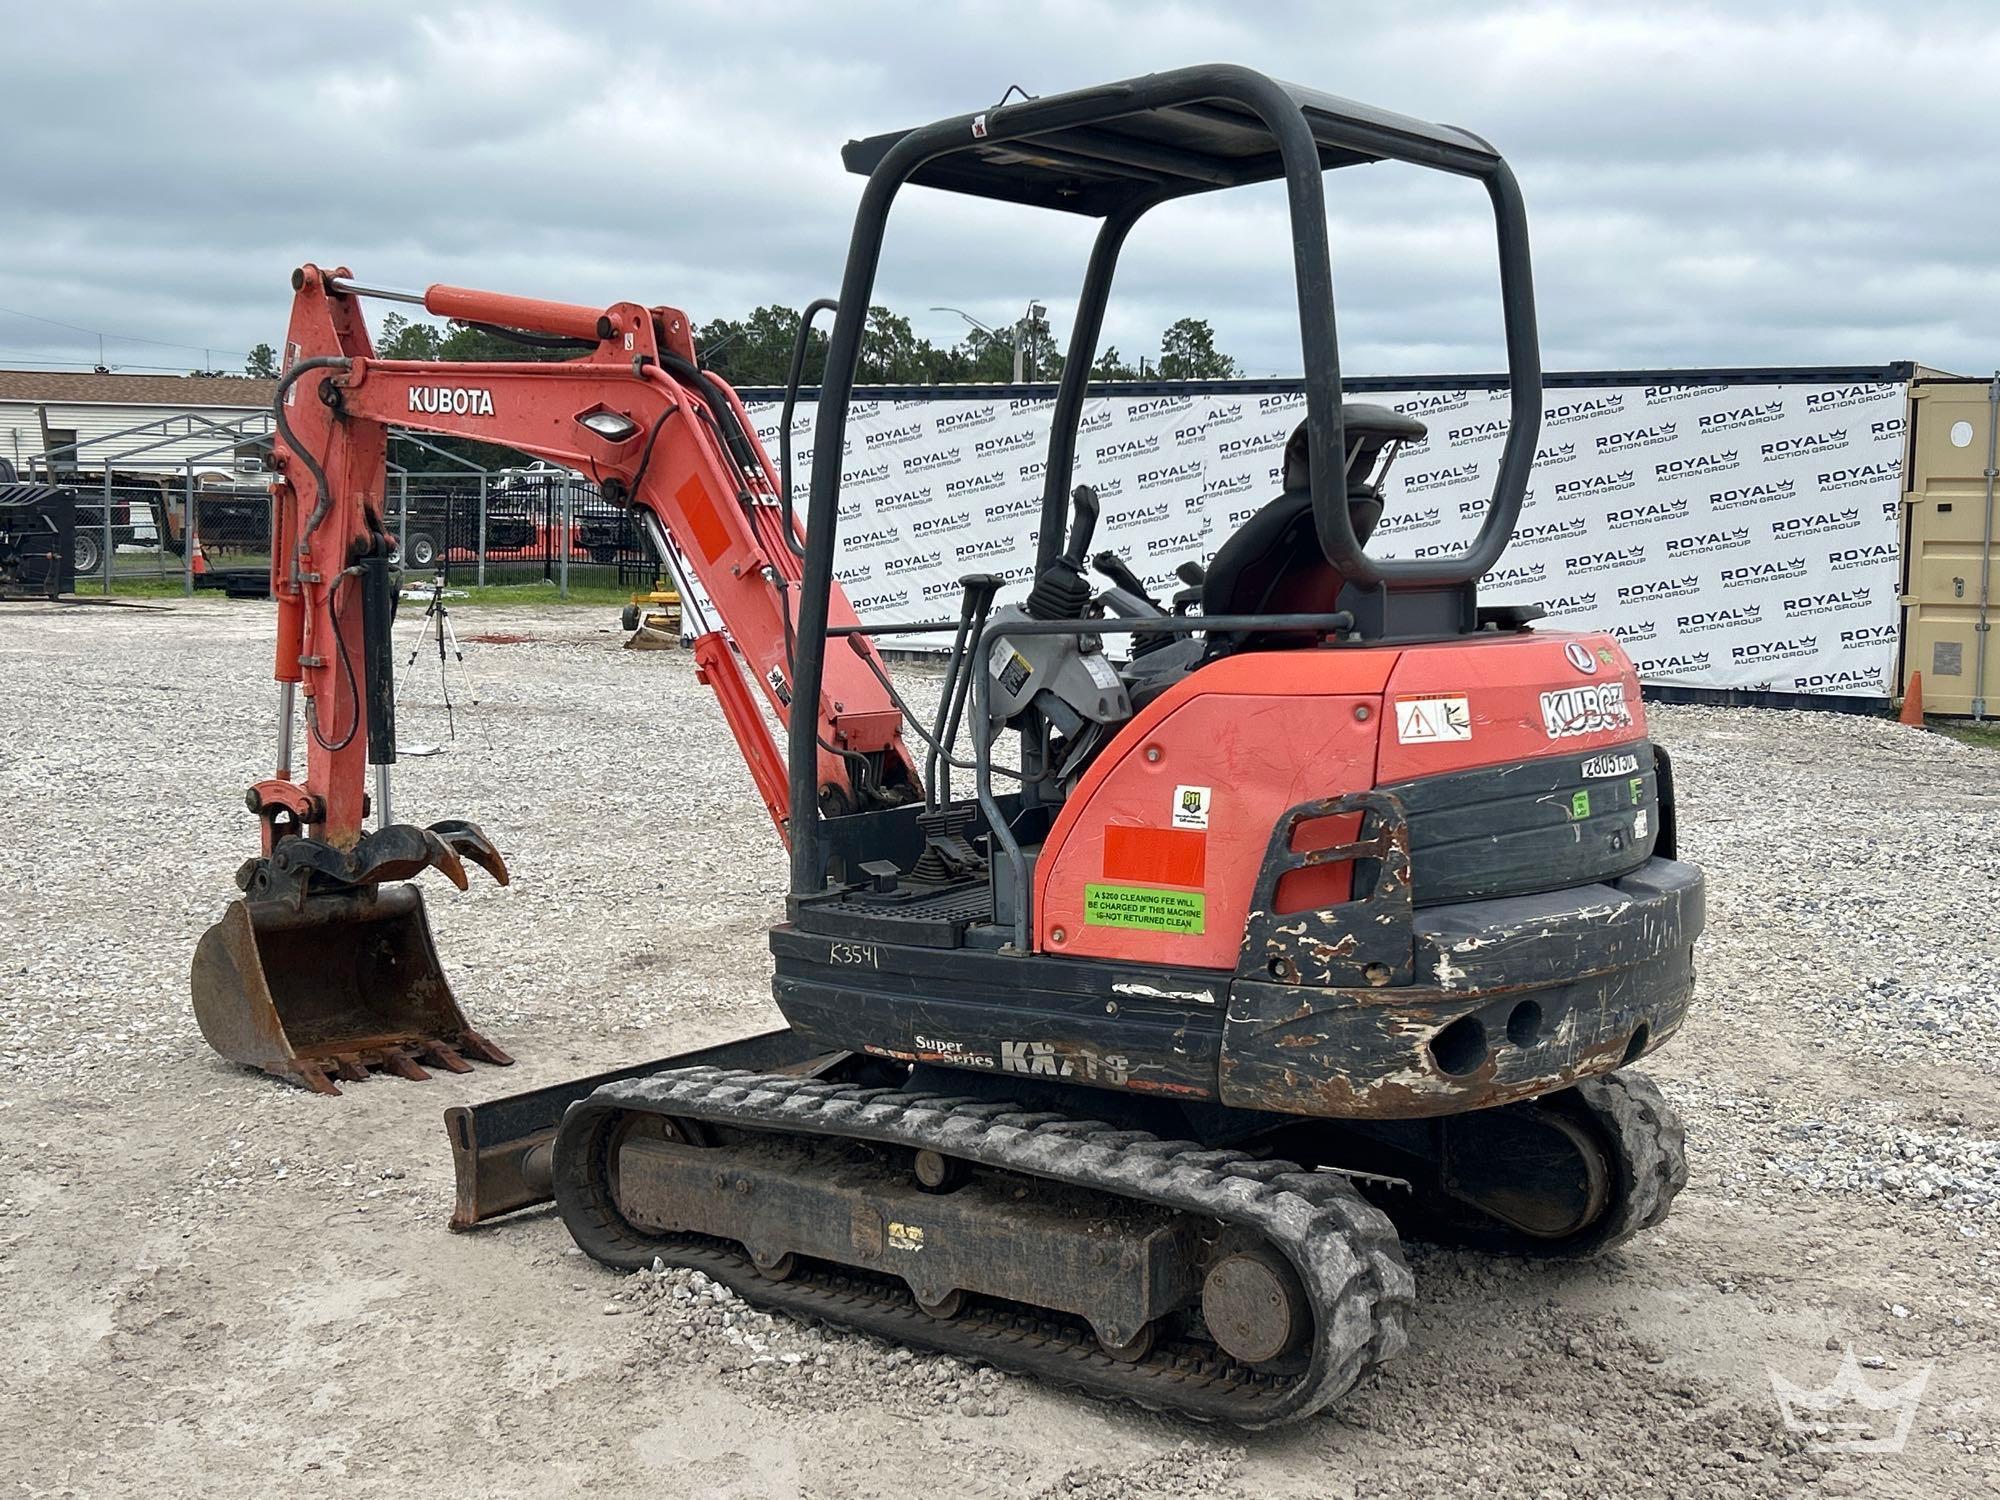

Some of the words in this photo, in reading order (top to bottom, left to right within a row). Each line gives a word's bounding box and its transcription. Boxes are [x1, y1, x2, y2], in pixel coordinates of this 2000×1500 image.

[408, 386, 496, 416] KUBOTA
[1394, 394, 1452, 413] ROYAL
[1646, 392, 1692, 406] AUCTION
[1693, 384, 1729, 397] GROUP
[1806, 383, 1877, 406] ROYAL
[1808, 399, 1857, 413] AUCTION
[1858, 391, 1897, 403] GROUP
[1127, 397, 1179, 416] ROYAL
[1129, 411, 1165, 423] AUCTION
[1165, 404, 1194, 416] GROUP
[1261, 404, 1299, 417] AUCTION
[1437, 402, 1470, 414] GROUP
[1544, 399, 1607, 420] ROYAL
[936, 410, 982, 427] ROYAL
[938, 423, 970, 434] AUCTION
[970, 416, 996, 427] GROUP
[1546, 414, 1589, 428] AUCTION
[1590, 406, 1625, 419] GROUP
[1699, 406, 1766, 427] ROYAL
[1701, 421, 1747, 435] AUCTION
[1748, 413, 1785, 426] GROUP
[865, 428, 909, 445] ROYAL
[867, 440, 897, 451] AUCTION
[898, 434, 923, 445] GROUP
[975, 434, 1022, 452] ROYAL
[1219, 435, 1273, 454] ROYAL
[1450, 436, 1492, 449] AUCTION
[1595, 427, 1660, 447] ROYAL
[1597, 442, 1641, 455] AUCTION
[1642, 434, 1678, 446] GROUP
[1760, 434, 1829, 455] ROYAL
[976, 447, 1009, 458] AUCTION
[1010, 440, 1036, 452] GROUP
[1096, 441, 1146, 459] ROYAL
[1098, 454, 1133, 466] AUCTION
[1133, 448, 1161, 459] GROUP
[1221, 448, 1258, 461] AUCTION
[1762, 449, 1810, 463] AUCTION
[1811, 441, 1849, 454] GROUP
[903, 451, 948, 468] ROYAL
[905, 463, 936, 474] AUCTION
[937, 457, 962, 468] GROUP
[1544, 455, 1577, 467] GROUP
[1655, 454, 1722, 474] ROYAL
[1138, 464, 1189, 482] ROYAL
[1139, 477, 1175, 489] AUCTION
[1176, 471, 1205, 482] GROUP
[1404, 468, 1464, 487] ROYAL
[1657, 469, 1703, 482] AUCTION
[1704, 461, 1740, 474] GROUP
[1818, 464, 1888, 485] ROYAL
[945, 475, 992, 491] ROYAL
[947, 487, 979, 498] AUCTION
[980, 481, 1006, 492] GROUP
[1406, 482, 1447, 494] AUCTION
[1448, 475, 1481, 487] GROUP
[1555, 474, 1618, 494] ROYAL
[1557, 489, 1601, 501] AUCTION
[1601, 482, 1637, 494] GROUP
[1820, 479, 1868, 493] AUCTION
[875, 490, 919, 506] ROYAL
[1710, 484, 1777, 505] ROYAL
[1712, 499, 1758, 512] AUCTION
[1759, 492, 1796, 504] GROUP
[877, 502, 907, 513] AUCTION
[908, 496, 933, 507] GROUP
[984, 500, 1032, 517] ROYAL
[986, 513, 1019, 523] AUCTION
[1106, 507, 1157, 524] ROYAL
[1108, 520, 1143, 531] AUCTION
[1143, 514, 1172, 525] GROUP
[1607, 504, 1671, 524] ROYAL
[1608, 519, 1653, 531] AUCTION
[1654, 512, 1690, 524] GROUP
[1772, 513, 1841, 533] ROYAL
[912, 516, 958, 532] ROYAL
[914, 528, 945, 538] AUCTION
[946, 522, 971, 533] GROUP
[1410, 520, 1441, 530] GROUP
[1774, 527, 1821, 541] AUCTION
[1822, 521, 1861, 533] GROUP
[843, 531, 886, 546] ROYAL
[844, 543, 874, 553] AUCTION
[875, 537, 899, 548] GROUP
[956, 539, 1002, 555] ROYAL
[1148, 533, 1199, 550] ROYAL
[1512, 537, 1555, 549] AUCTION
[1556, 530, 1590, 542] GROUP
[1666, 532, 1732, 551] ROYAL
[957, 551, 989, 561] AUCTION
[990, 546, 1016, 556] GROUP
[1149, 546, 1185, 557] AUCTION
[1668, 546, 1713, 559] AUCTION
[1714, 540, 1751, 551] GROUP
[885, 555, 929, 570] ROYAL
[1565, 550, 1629, 569] ROYAL
[1567, 564, 1611, 576] AUCTION
[1612, 558, 1647, 569] GROUP
[1831, 558, 1880, 571] AUCTION
[886, 567, 917, 577] AUCTION
[918, 562, 943, 572] GROUP
[1721, 562, 1789, 582] ROYAL
[1514, 575, 1547, 586] GROUP
[1723, 576, 1769, 589] AUCTION
[1770, 570, 1808, 582] GROUP
[1618, 580, 1683, 599] ROYAL
[1620, 594, 1664, 606] AUCTION
[1665, 588, 1701, 599] GROUP
[852, 594, 896, 609] ROYAL
[854, 605, 884, 615] AUCTION
[885, 601, 909, 611] GROUP
[1565, 604, 1598, 615] GROUP
[1783, 591, 1853, 611] ROYAL
[1785, 606, 1833, 618] AUCTION
[1834, 600, 1872, 611] GROUP
[1677, 608, 1743, 627] ROYAL
[1679, 622, 1724, 634] AUCTION
[1725, 617, 1762, 628] GROUP
[1732, 640, 1800, 658] ROYAL
[1734, 653, 1781, 665] AUCTION
[1782, 648, 1819, 659] GROUP
[1675, 664, 1711, 674] GROUP
[1794, 671, 1864, 689] ROYAL
[1845, 680, 1883, 690] GROUP
[1183, 791, 1201, 806] 811
[1120, 893, 1160, 904] CLEANING
[1161, 896, 1176, 905] FEE
[1176, 898, 1195, 907] WILL
[1087, 901, 1099, 909] BE
[1099, 902, 1138, 912] CHARGED
[1148, 906, 1165, 914] THIS
[1166, 907, 1201, 918] MACHINE
[1105, 912, 1122, 921] NOT
[1123, 914, 1165, 925] RETURNED
[1166, 918, 1192, 927] CLEAN
[830, 942, 879, 969] K3541
[915, 1036, 963, 1052] Super
[943, 1051, 994, 1067] Series
